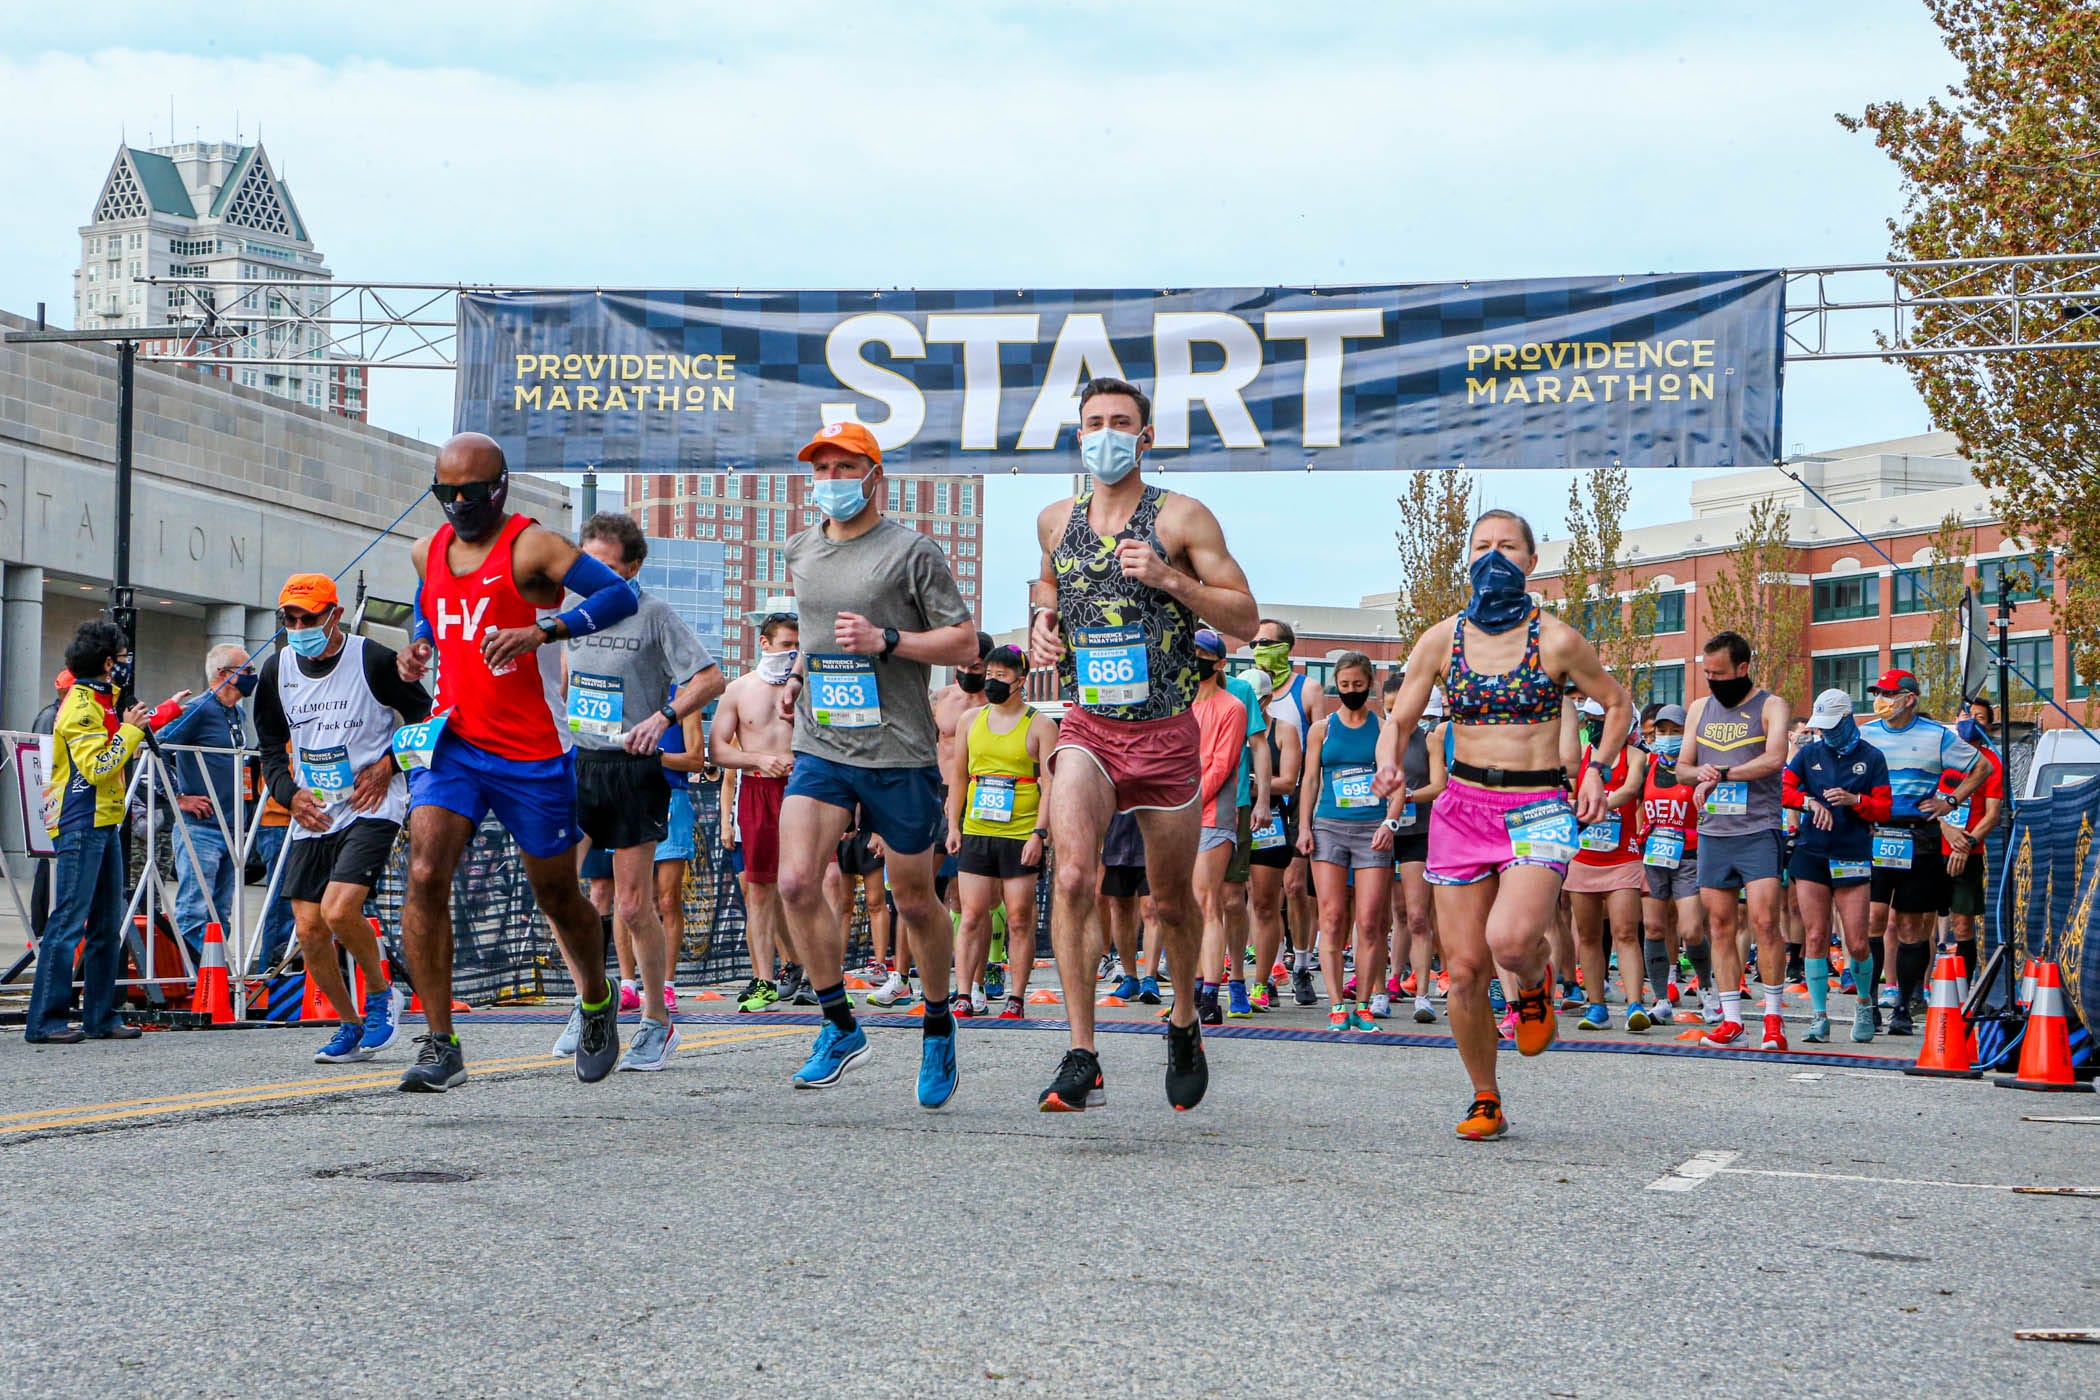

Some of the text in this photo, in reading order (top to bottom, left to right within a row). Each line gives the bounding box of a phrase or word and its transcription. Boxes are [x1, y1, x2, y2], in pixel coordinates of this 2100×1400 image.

[1466, 339, 1716, 371] PROVIDENCE
[515, 354, 737, 381] PROVIDENCE
[821, 307, 1384, 451] START
[1466, 374, 1714, 404] MARATHON
[514, 385, 735, 411] MARATHON
[0, 483, 246, 571] TAION
[1088, 658, 1134, 683] 686
[822, 685, 865, 706] 363
[291, 700, 348, 715] FALMOUTH
[577, 698, 611, 718] 379
[317, 718, 364, 731] Track Club
[1704, 722, 1749, 743] SBRC
[398, 726, 430, 748] 375
[311, 771, 343, 788] 655
[1342, 782, 1370, 796] 695
[978, 793, 1005, 808] 393
[1713, 788, 1737, 802] 121
[1644, 799, 1688, 819] BEN
[1586, 826, 1612, 840] 302
[1652, 843, 1675, 857] 220
[1880, 844, 1905, 857] 507
